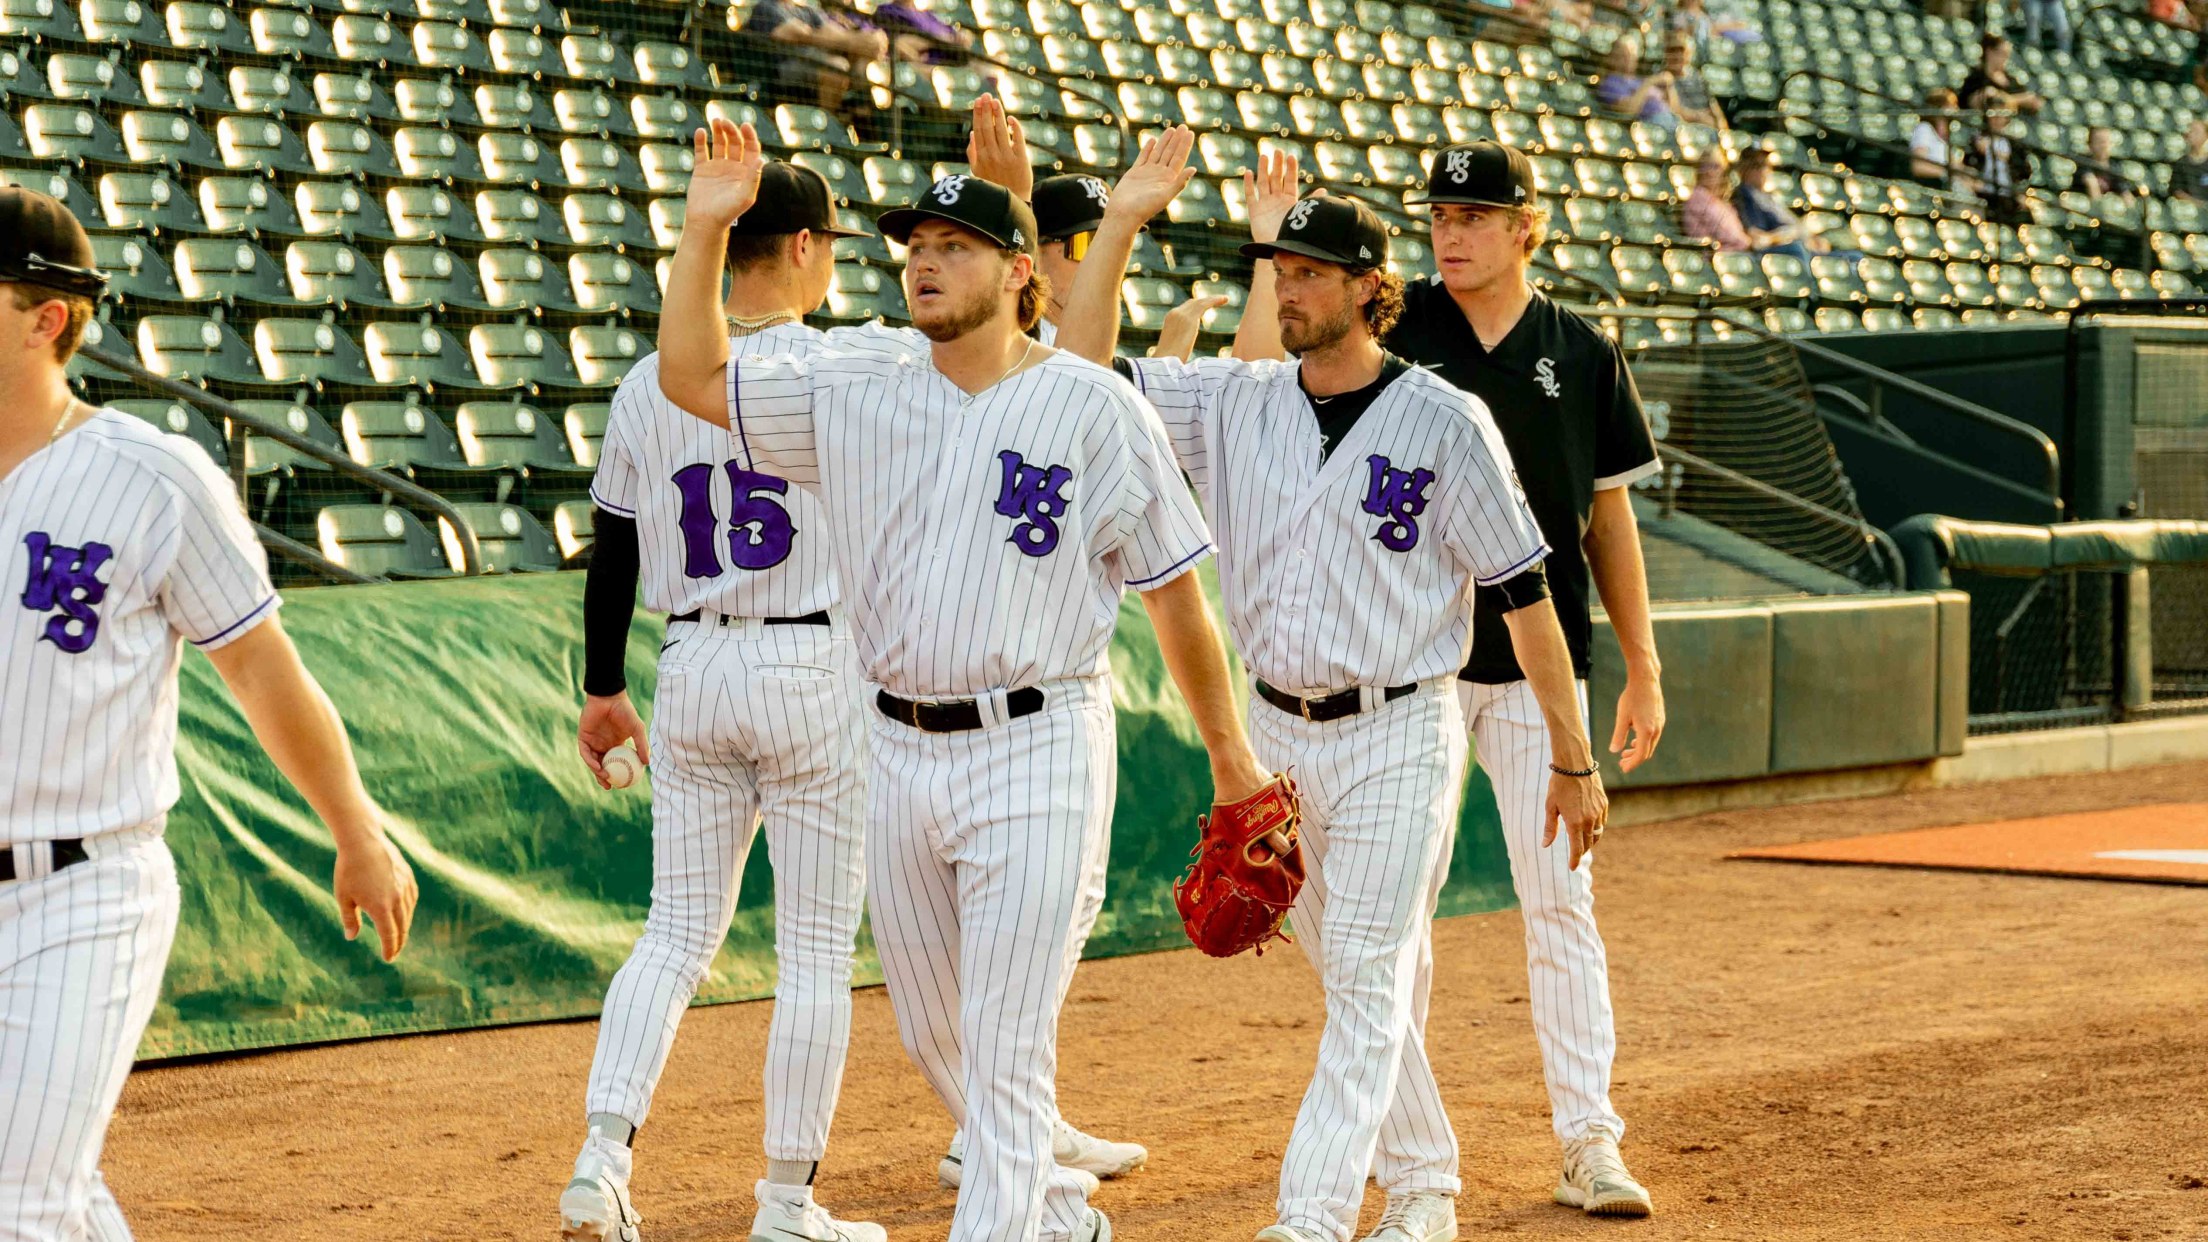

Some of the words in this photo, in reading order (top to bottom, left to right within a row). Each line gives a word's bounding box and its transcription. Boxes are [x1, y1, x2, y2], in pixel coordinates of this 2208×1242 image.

[671, 459, 798, 578] 15
[994, 450, 1073, 557] WS
[1361, 454, 1435, 552] WS
[20, 531, 113, 654] WS
